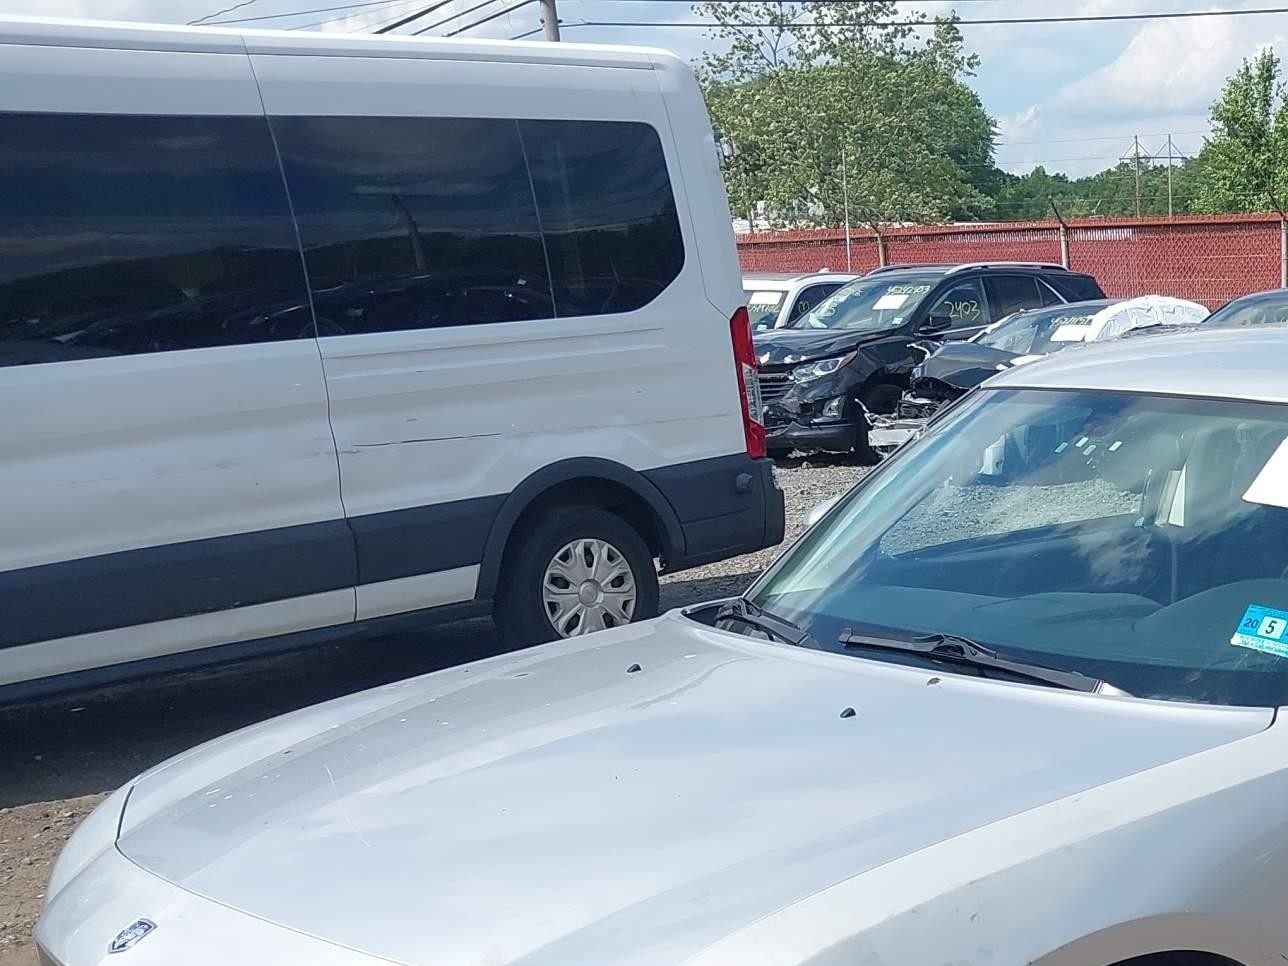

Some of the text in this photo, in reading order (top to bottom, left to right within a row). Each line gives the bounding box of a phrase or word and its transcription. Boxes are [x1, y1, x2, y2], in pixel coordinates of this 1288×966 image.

[944, 300, 981, 321] 2403
[1243, 617, 1260, 630] 20
[1265, 619, 1278, 634] 5
